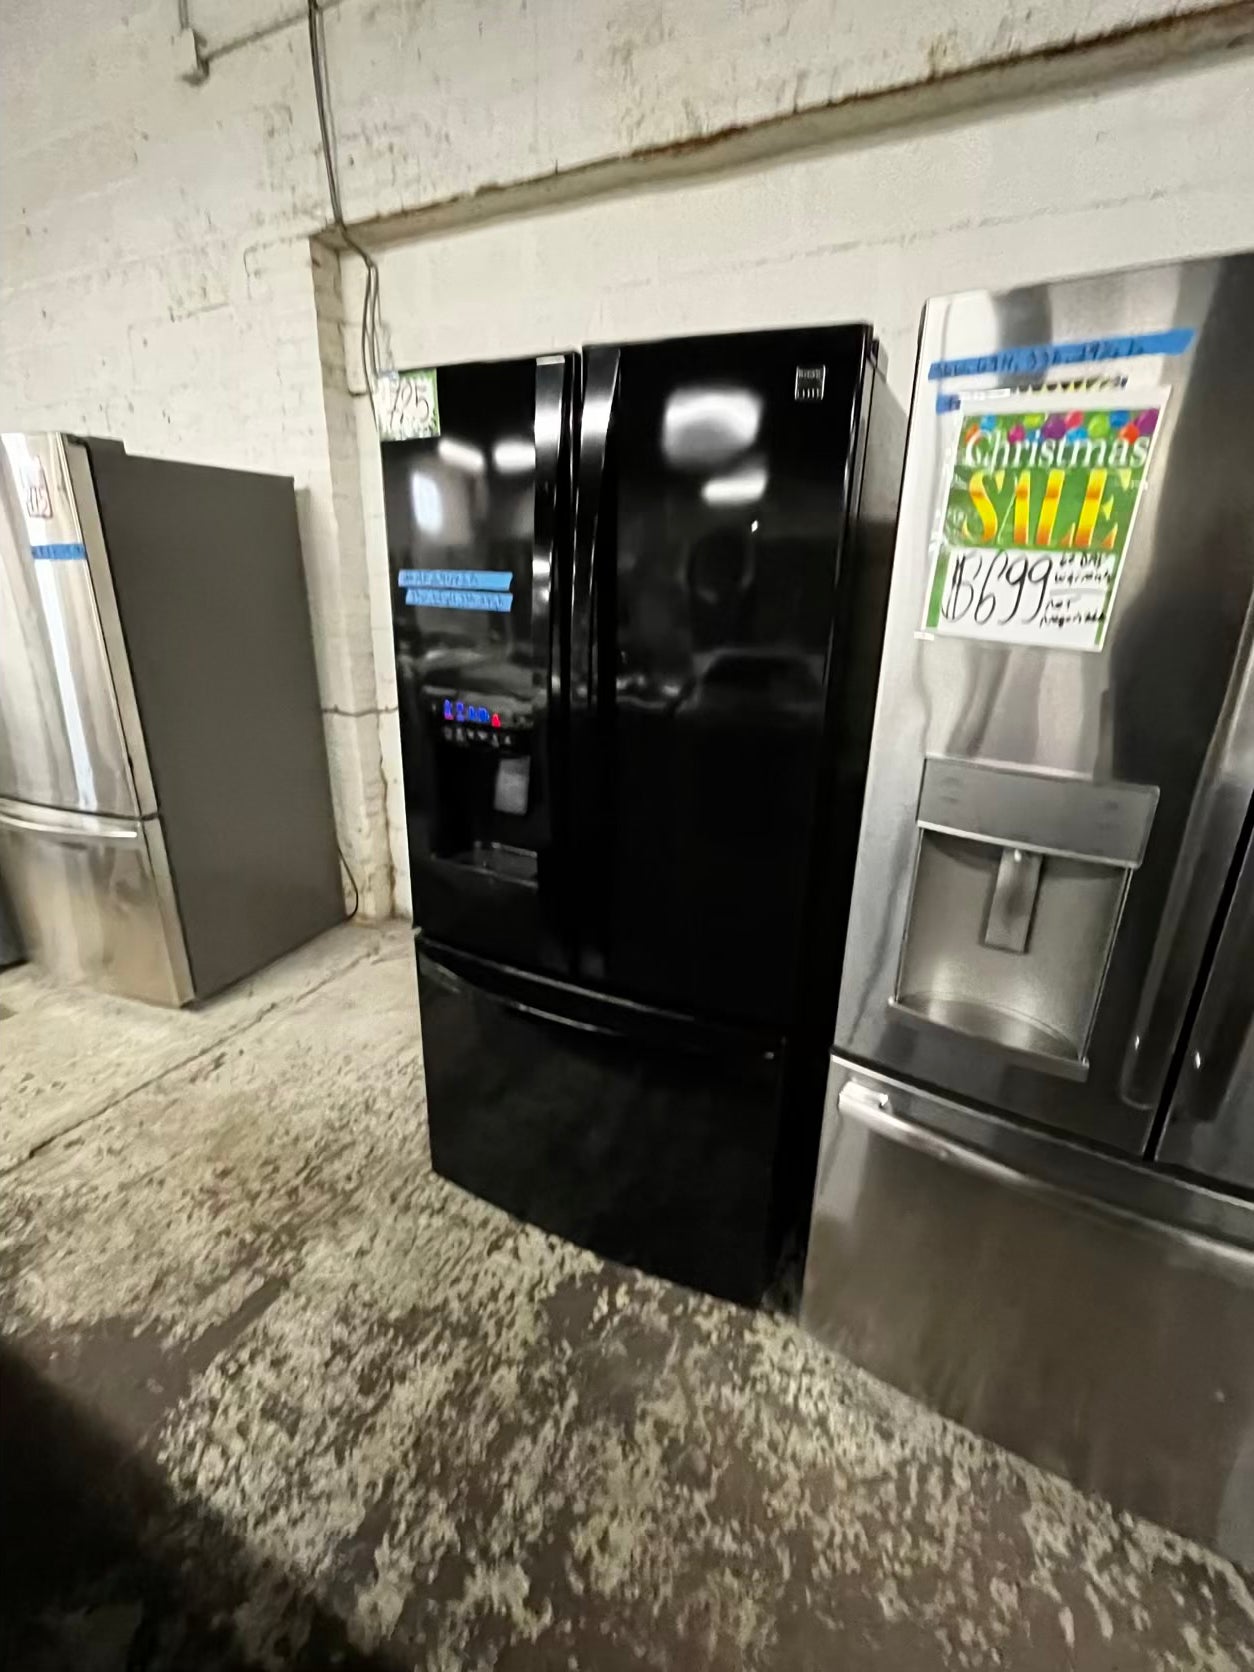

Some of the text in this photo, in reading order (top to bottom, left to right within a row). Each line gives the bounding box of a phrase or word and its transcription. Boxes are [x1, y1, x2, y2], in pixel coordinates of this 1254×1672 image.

[964, 429, 1150, 475] Christmas
[962, 468, 1132, 549] SALE
[941, 549, 1053, 625] $699
